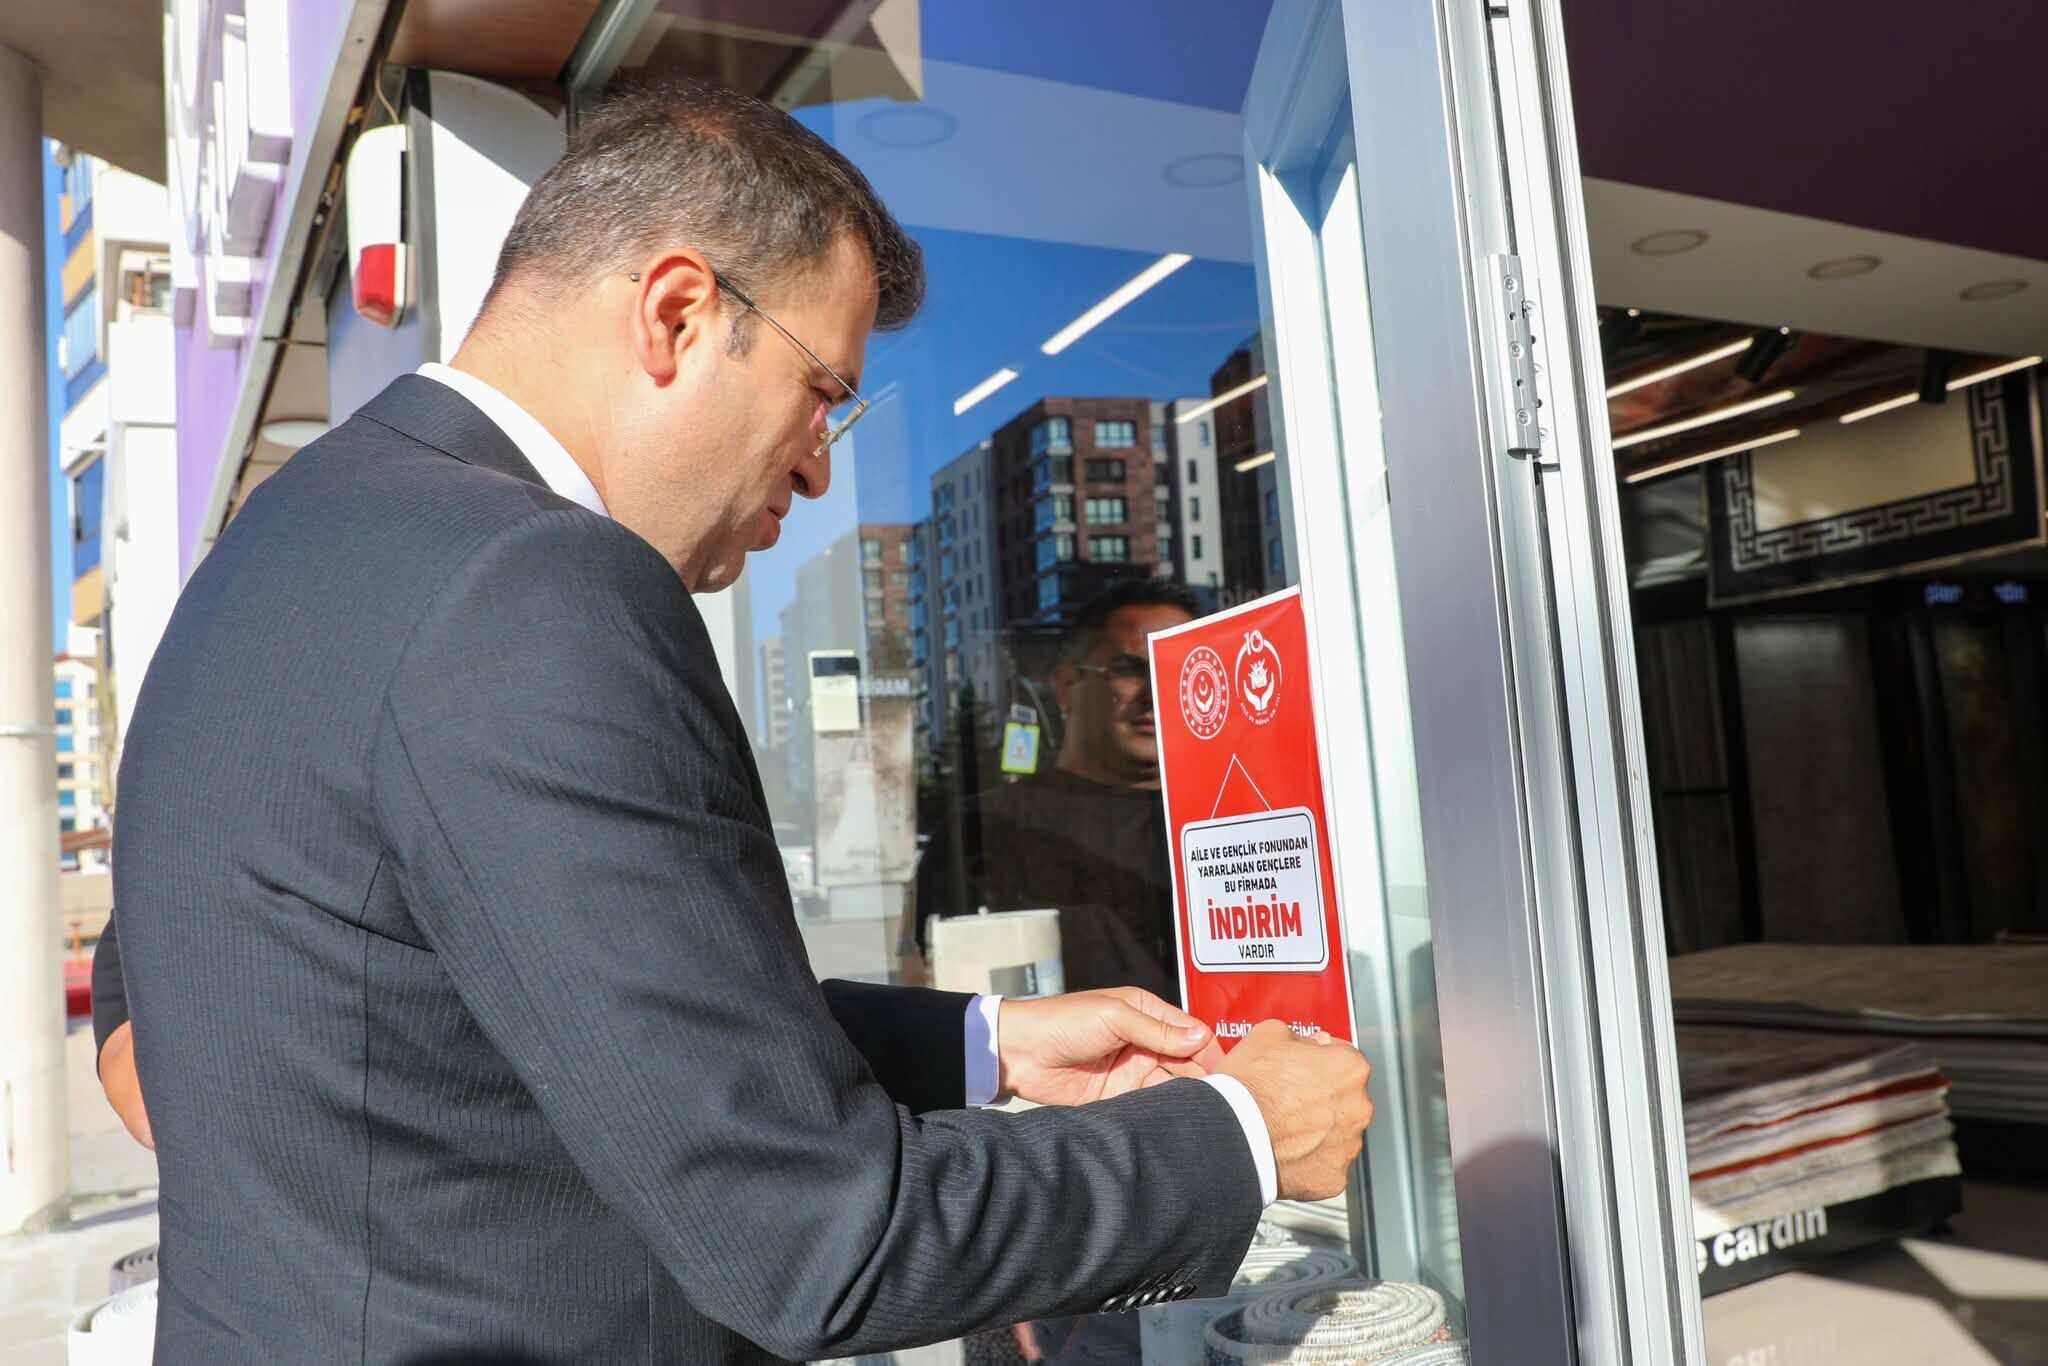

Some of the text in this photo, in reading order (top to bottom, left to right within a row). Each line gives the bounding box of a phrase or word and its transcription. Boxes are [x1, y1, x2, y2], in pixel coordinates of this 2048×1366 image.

[1191, 836, 1308, 862] AİLE VE GENÇLİK FONUNDAN
[1198, 856, 1301, 878] YARARLANAN GENÇLERE
[1225, 876, 1277, 892] BU FİRMADA
[1208, 893, 1303, 940] İNDİRİM
[1238, 944, 1275, 960] VARDIR
[1713, 1206, 1828, 1267] cardin
